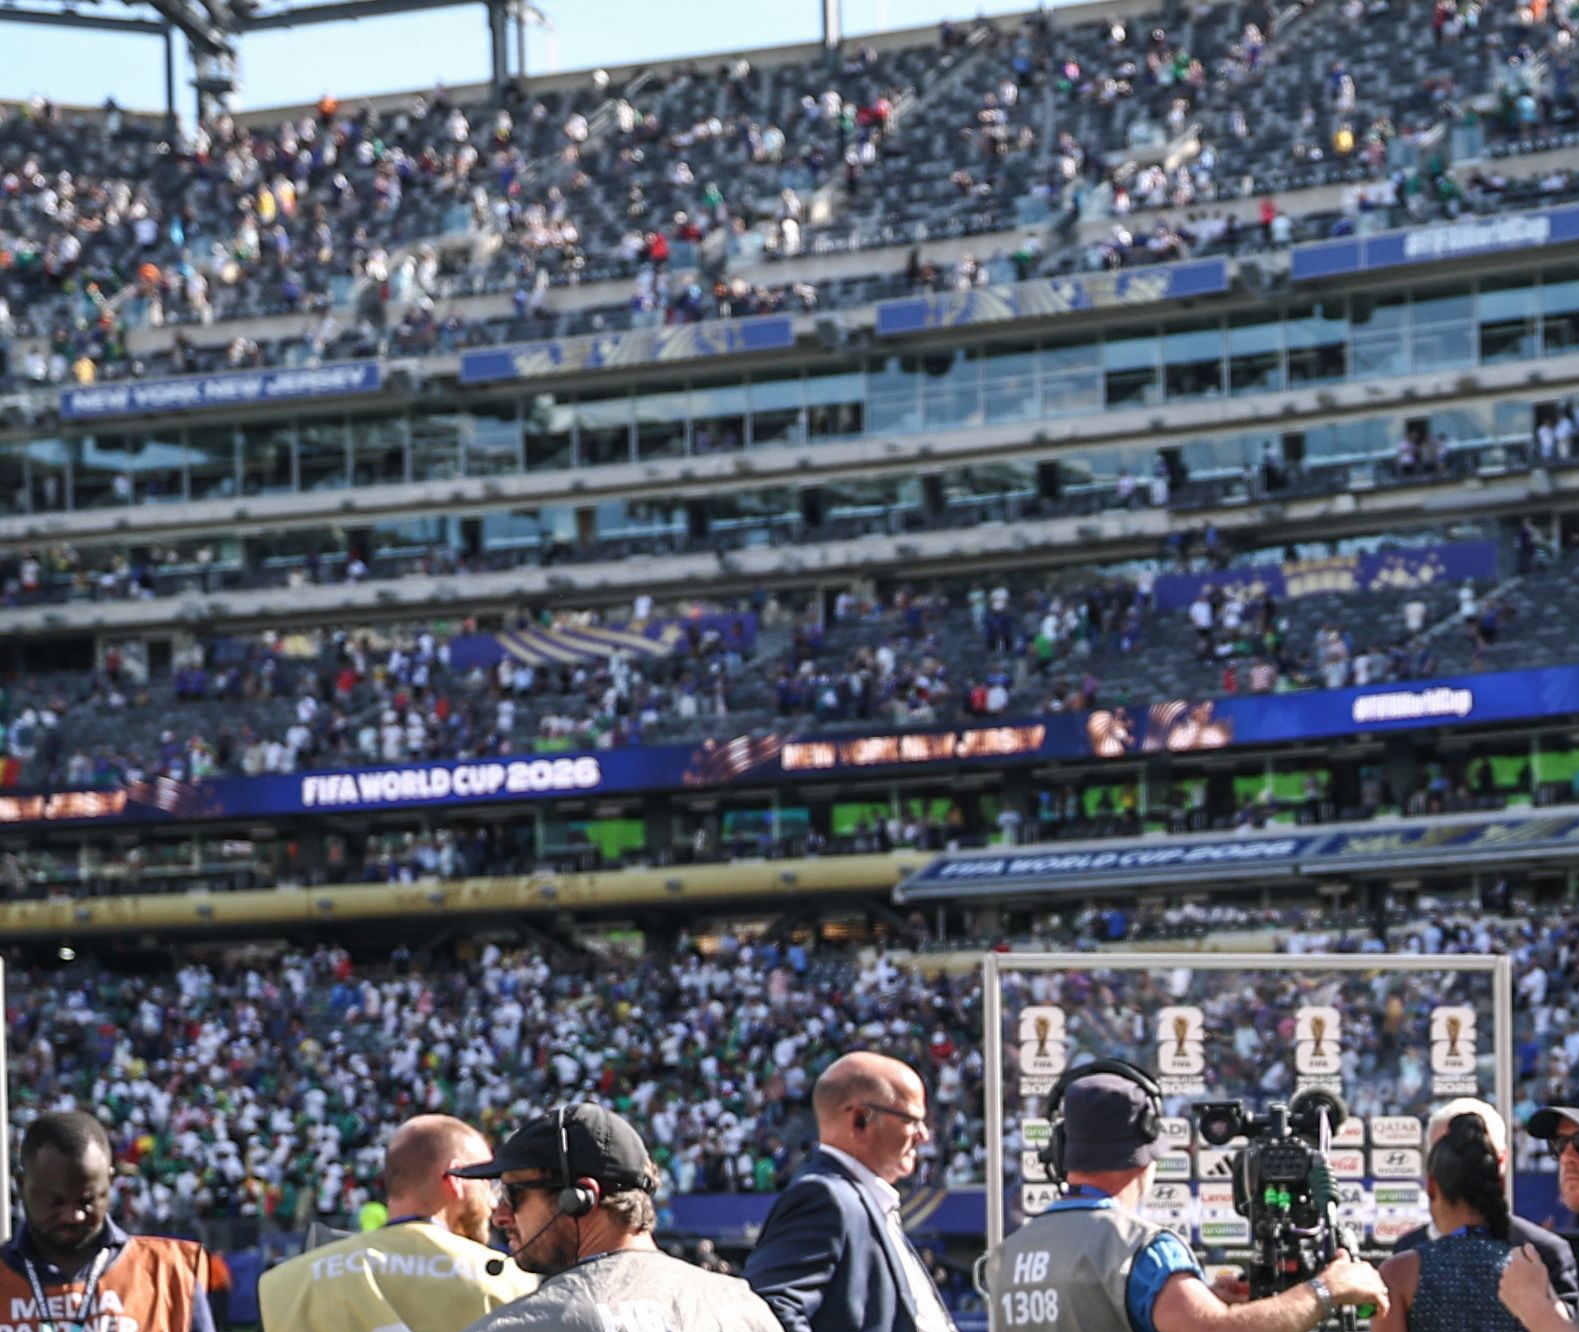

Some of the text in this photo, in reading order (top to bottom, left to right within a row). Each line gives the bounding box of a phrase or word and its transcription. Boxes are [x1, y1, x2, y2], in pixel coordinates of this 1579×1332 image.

[302, 756, 600, 806] FIFA WORLD CUP 2026
[1374, 1122, 1418, 1134] QATAR
[1376, 1190, 1419, 1200] aramco
[1202, 1224, 1247, 1236] aramco
[1013, 1250, 1051, 1285] HB
[1002, 1288, 1059, 1325] 1308
